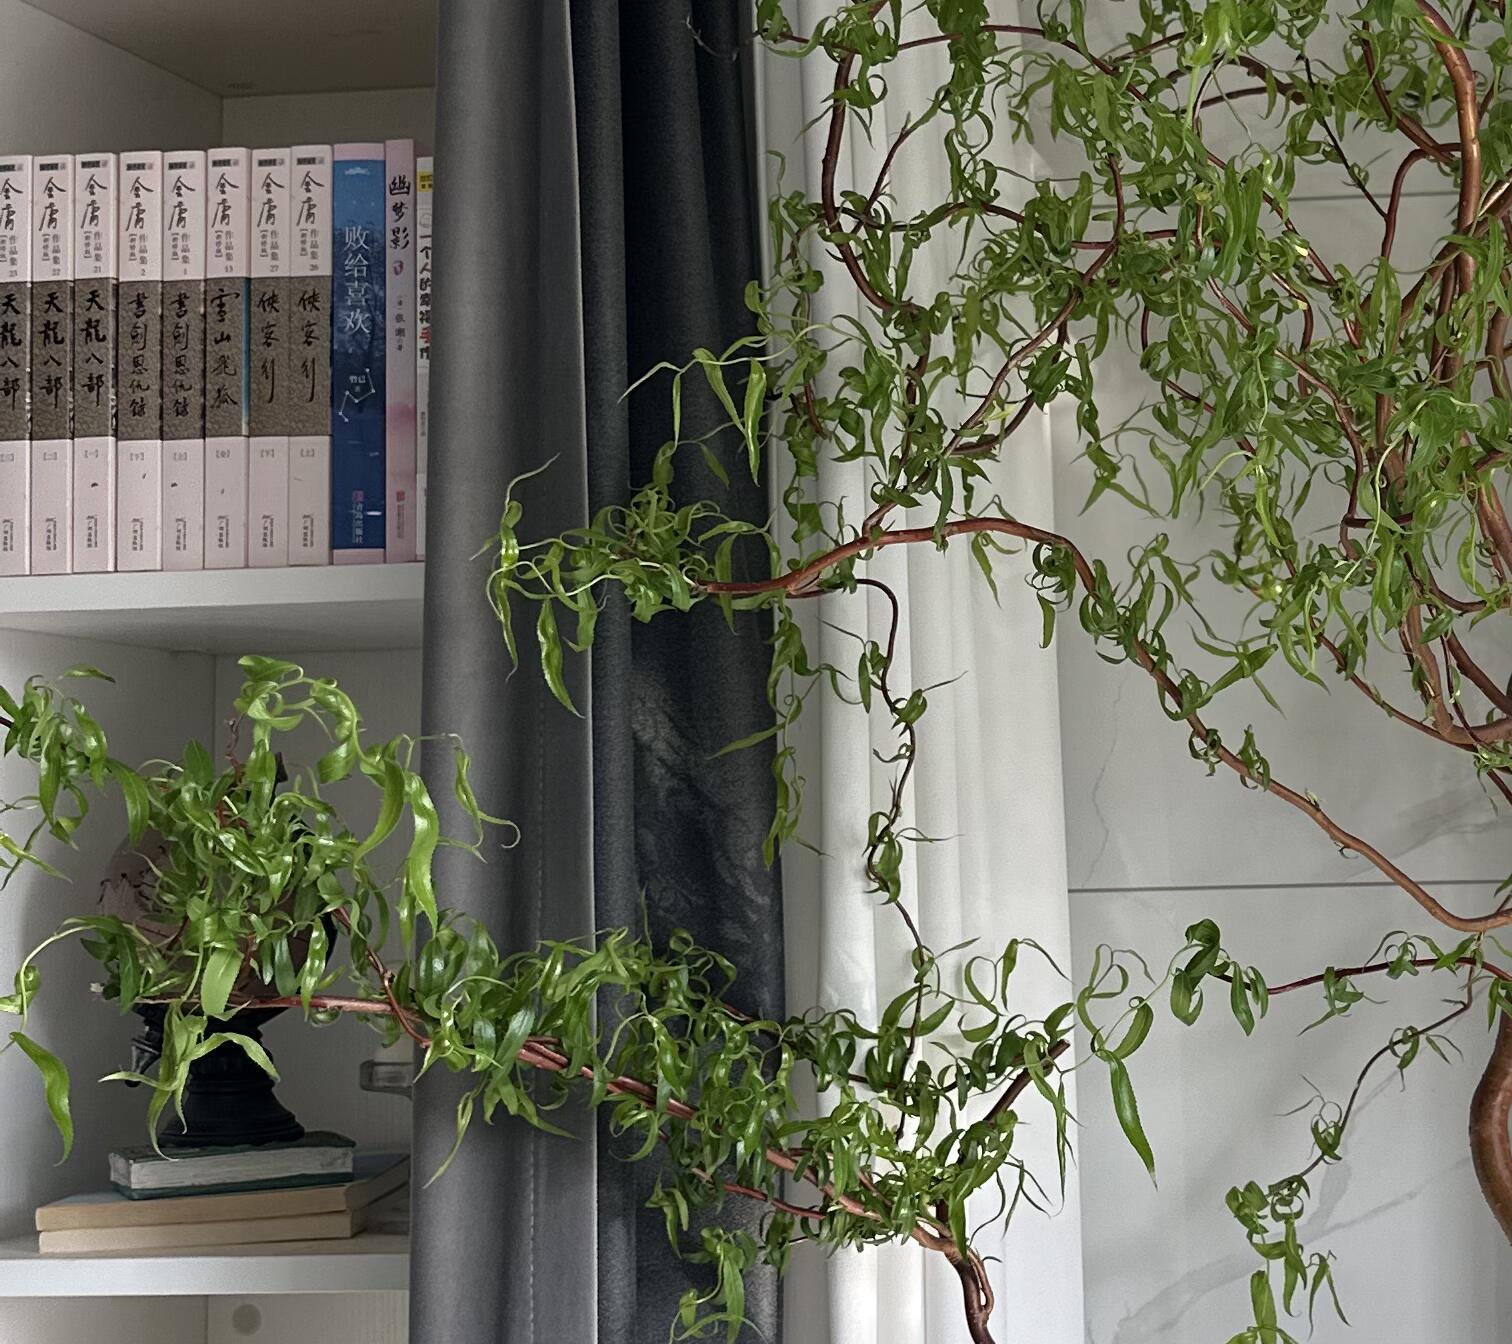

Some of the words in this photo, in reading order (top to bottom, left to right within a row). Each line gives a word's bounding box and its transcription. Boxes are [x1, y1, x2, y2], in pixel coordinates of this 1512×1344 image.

[39, 177, 66, 231] 金庸
[81, 174, 108, 229] 金庸
[125, 176, 154, 231] 金庸
[168, 176, 196, 230] 金庸
[212, 173, 239, 228] 金庸
[257, 173, 285, 227] 金庸
[296, 171, 324, 226] 金庸
[388, 174, 411, 250] 幽梦影
[344, 225, 371, 334] 败给喜欢
[38, 291, 65, 409] 天龍八部
[80, 289, 107, 407] 天龍八部
